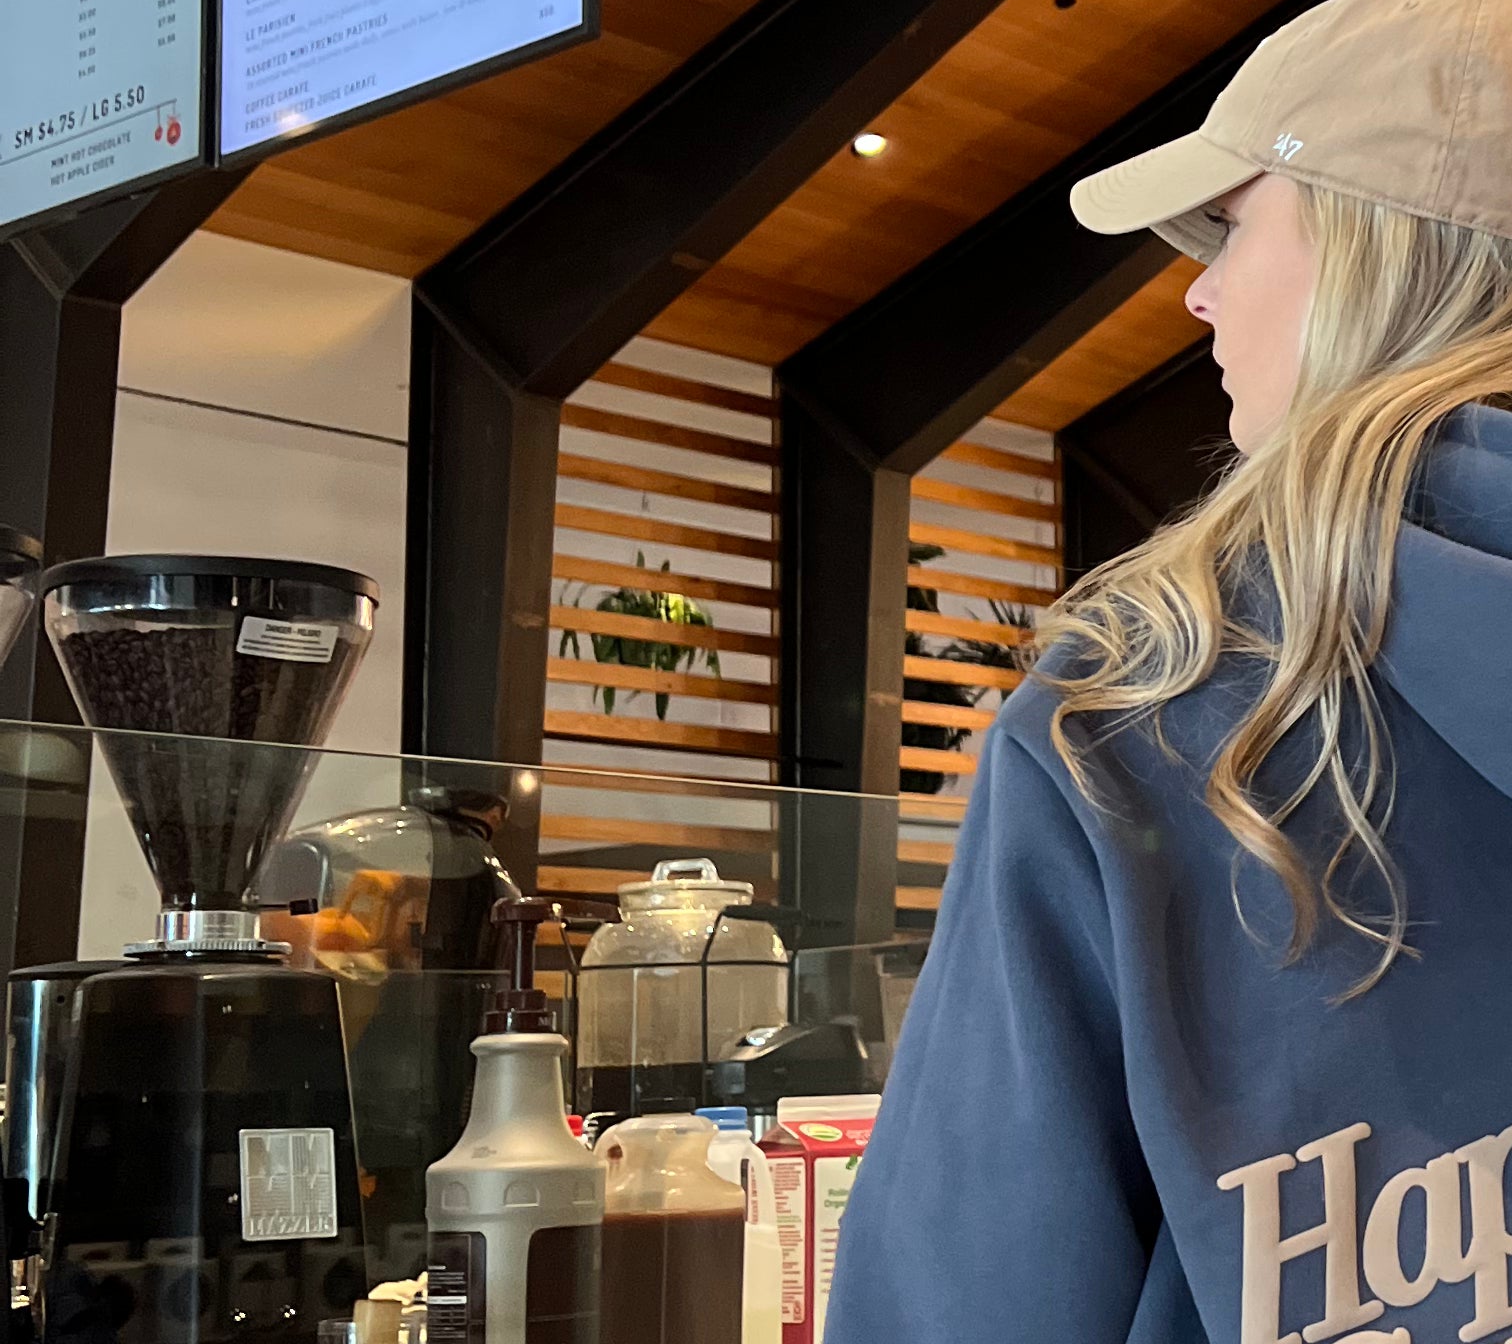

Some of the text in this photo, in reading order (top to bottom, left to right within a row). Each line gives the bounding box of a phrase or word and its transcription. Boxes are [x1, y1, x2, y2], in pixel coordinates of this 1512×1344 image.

[258, 13, 296, 35] PARISIEN
[246, 52, 288, 77] ASSORTED
[310, 31, 344, 52] FRENCH
[346, 13, 388, 39] PASTRIES
[245, 115, 271, 133] FRESH
[317, 88, 341, 105] JUICE
[344, 73, 377, 96] CARAFE
[246, 92, 276, 115] COFFEE
[278, 80, 310, 102] CARAFE
[15, 128, 33, 150] SM
[38, 111, 75, 142] $4.75
[92, 99, 109, 121] LG
[115, 85, 145, 113] 5.50
[51, 131, 131, 169] MINT HOT CHOCOLATE
[51, 155, 115, 187] HOT APPLE CIDER
